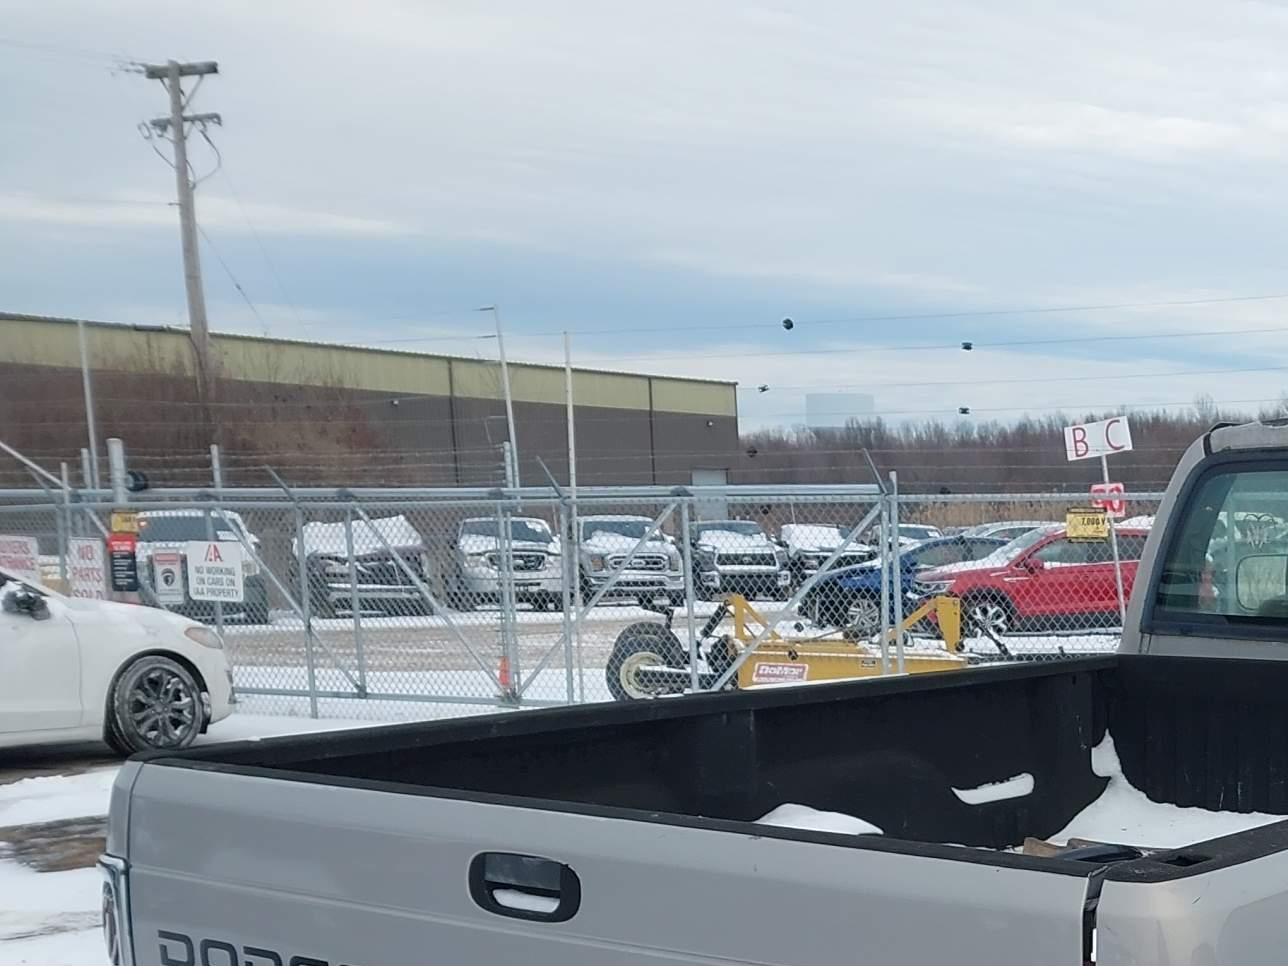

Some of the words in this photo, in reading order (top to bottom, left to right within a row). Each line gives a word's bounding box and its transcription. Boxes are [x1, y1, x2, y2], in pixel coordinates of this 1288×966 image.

[1072, 427, 1089, 458] B
[1105, 419, 1125, 451] C
[78, 544, 95, 561] NO
[194, 566, 205, 575] NO
[206, 566, 236, 577] WORKING
